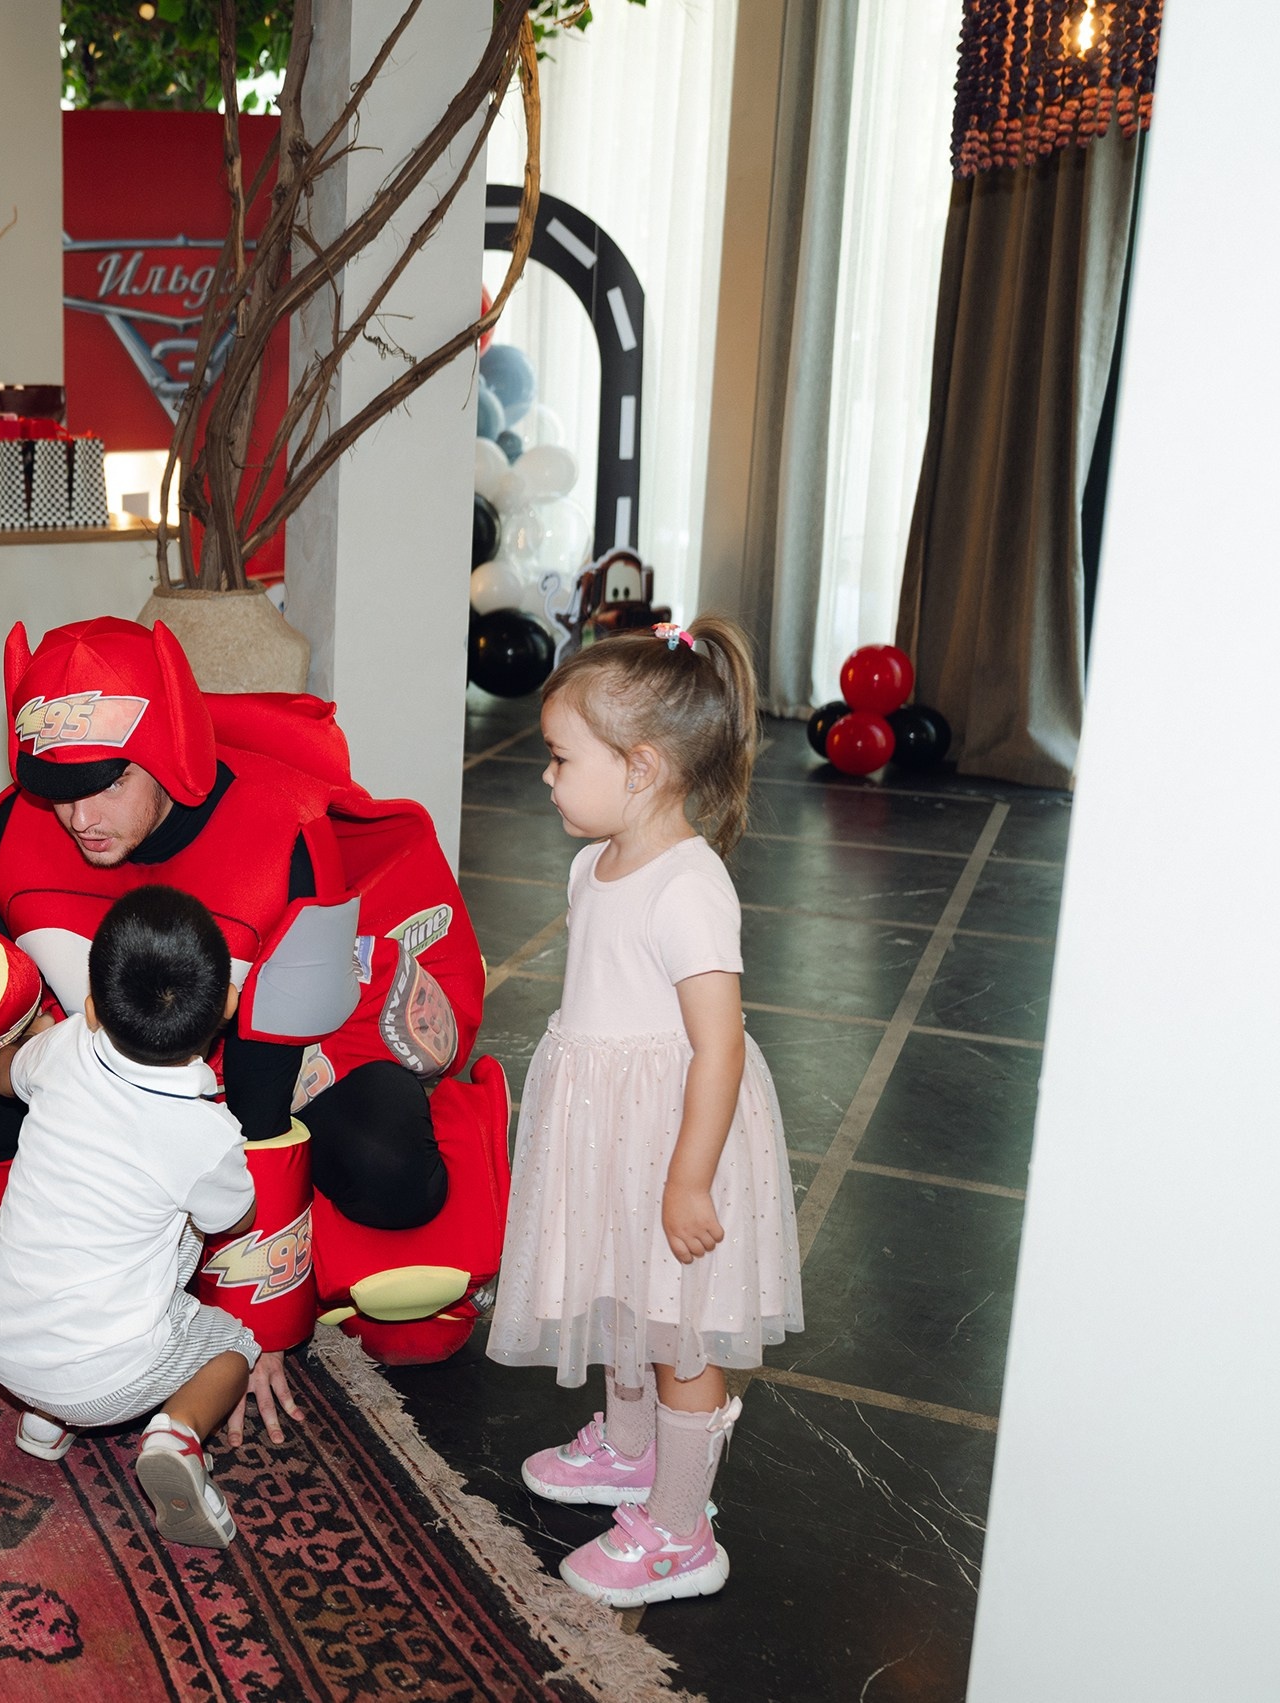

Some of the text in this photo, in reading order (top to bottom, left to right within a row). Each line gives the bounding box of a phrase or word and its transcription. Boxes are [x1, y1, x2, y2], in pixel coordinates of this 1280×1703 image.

[96, 251, 254, 310] Ильд
[40, 701, 96, 741] 95
[267, 1220, 312, 1288] 95
